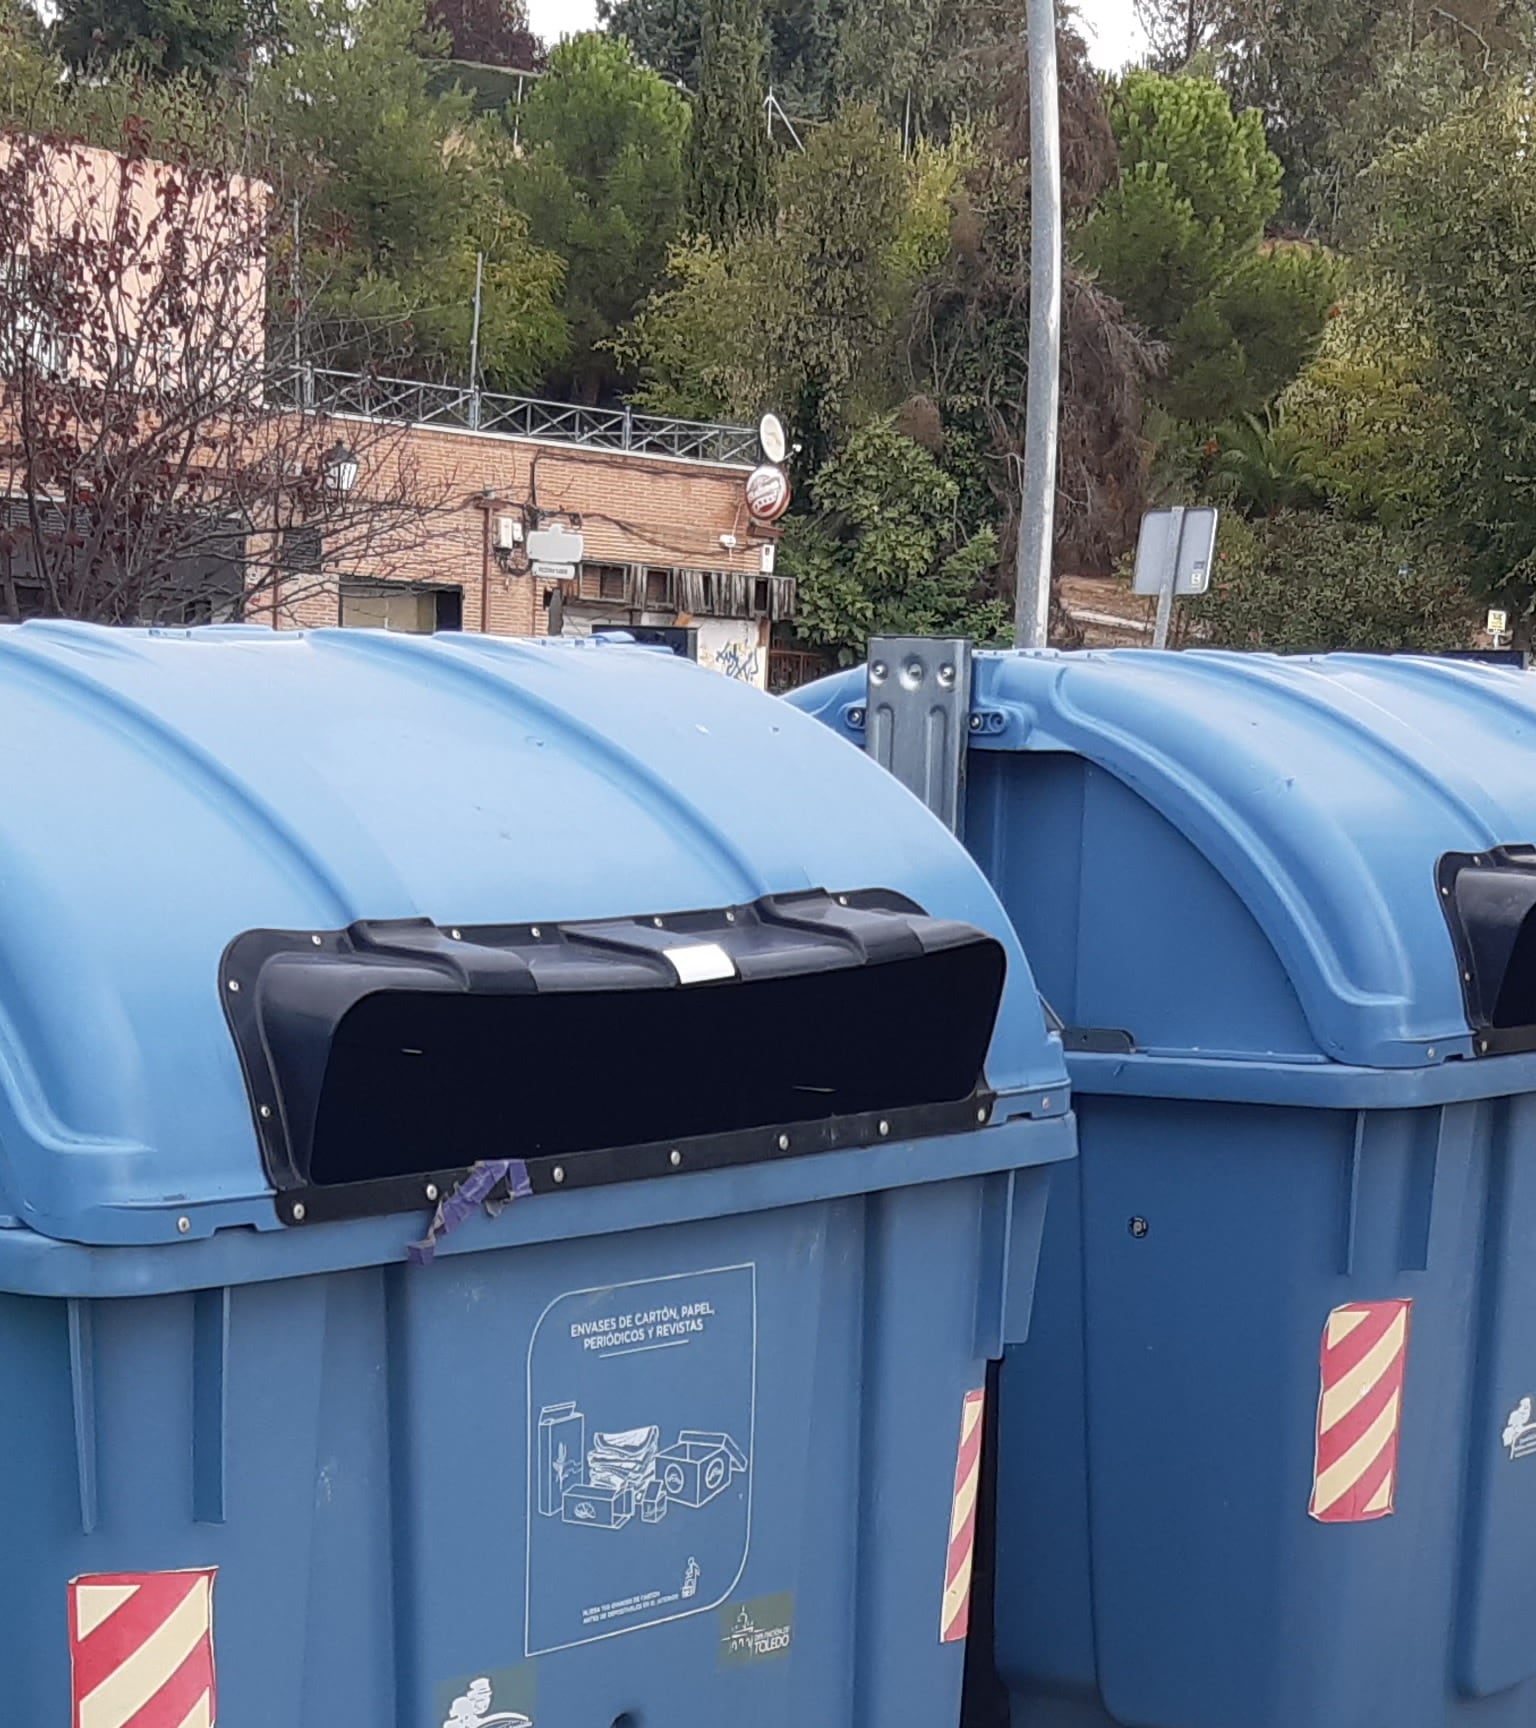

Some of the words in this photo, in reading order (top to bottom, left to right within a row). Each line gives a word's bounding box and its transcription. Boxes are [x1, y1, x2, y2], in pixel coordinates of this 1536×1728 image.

[570, 1317, 617, 1337] ENVASES
[618, 1314, 633, 1329] DE
[634, 1305, 680, 1326] CARTÓN,
[681, 1302, 715, 1317] PAPEL,
[583, 1329, 645, 1350] PERIÓDICOS
[647, 1327, 655, 1339] Y
[656, 1319, 704, 1338] REVISTAS
[754, 1634, 790, 1654] TOLEDO
